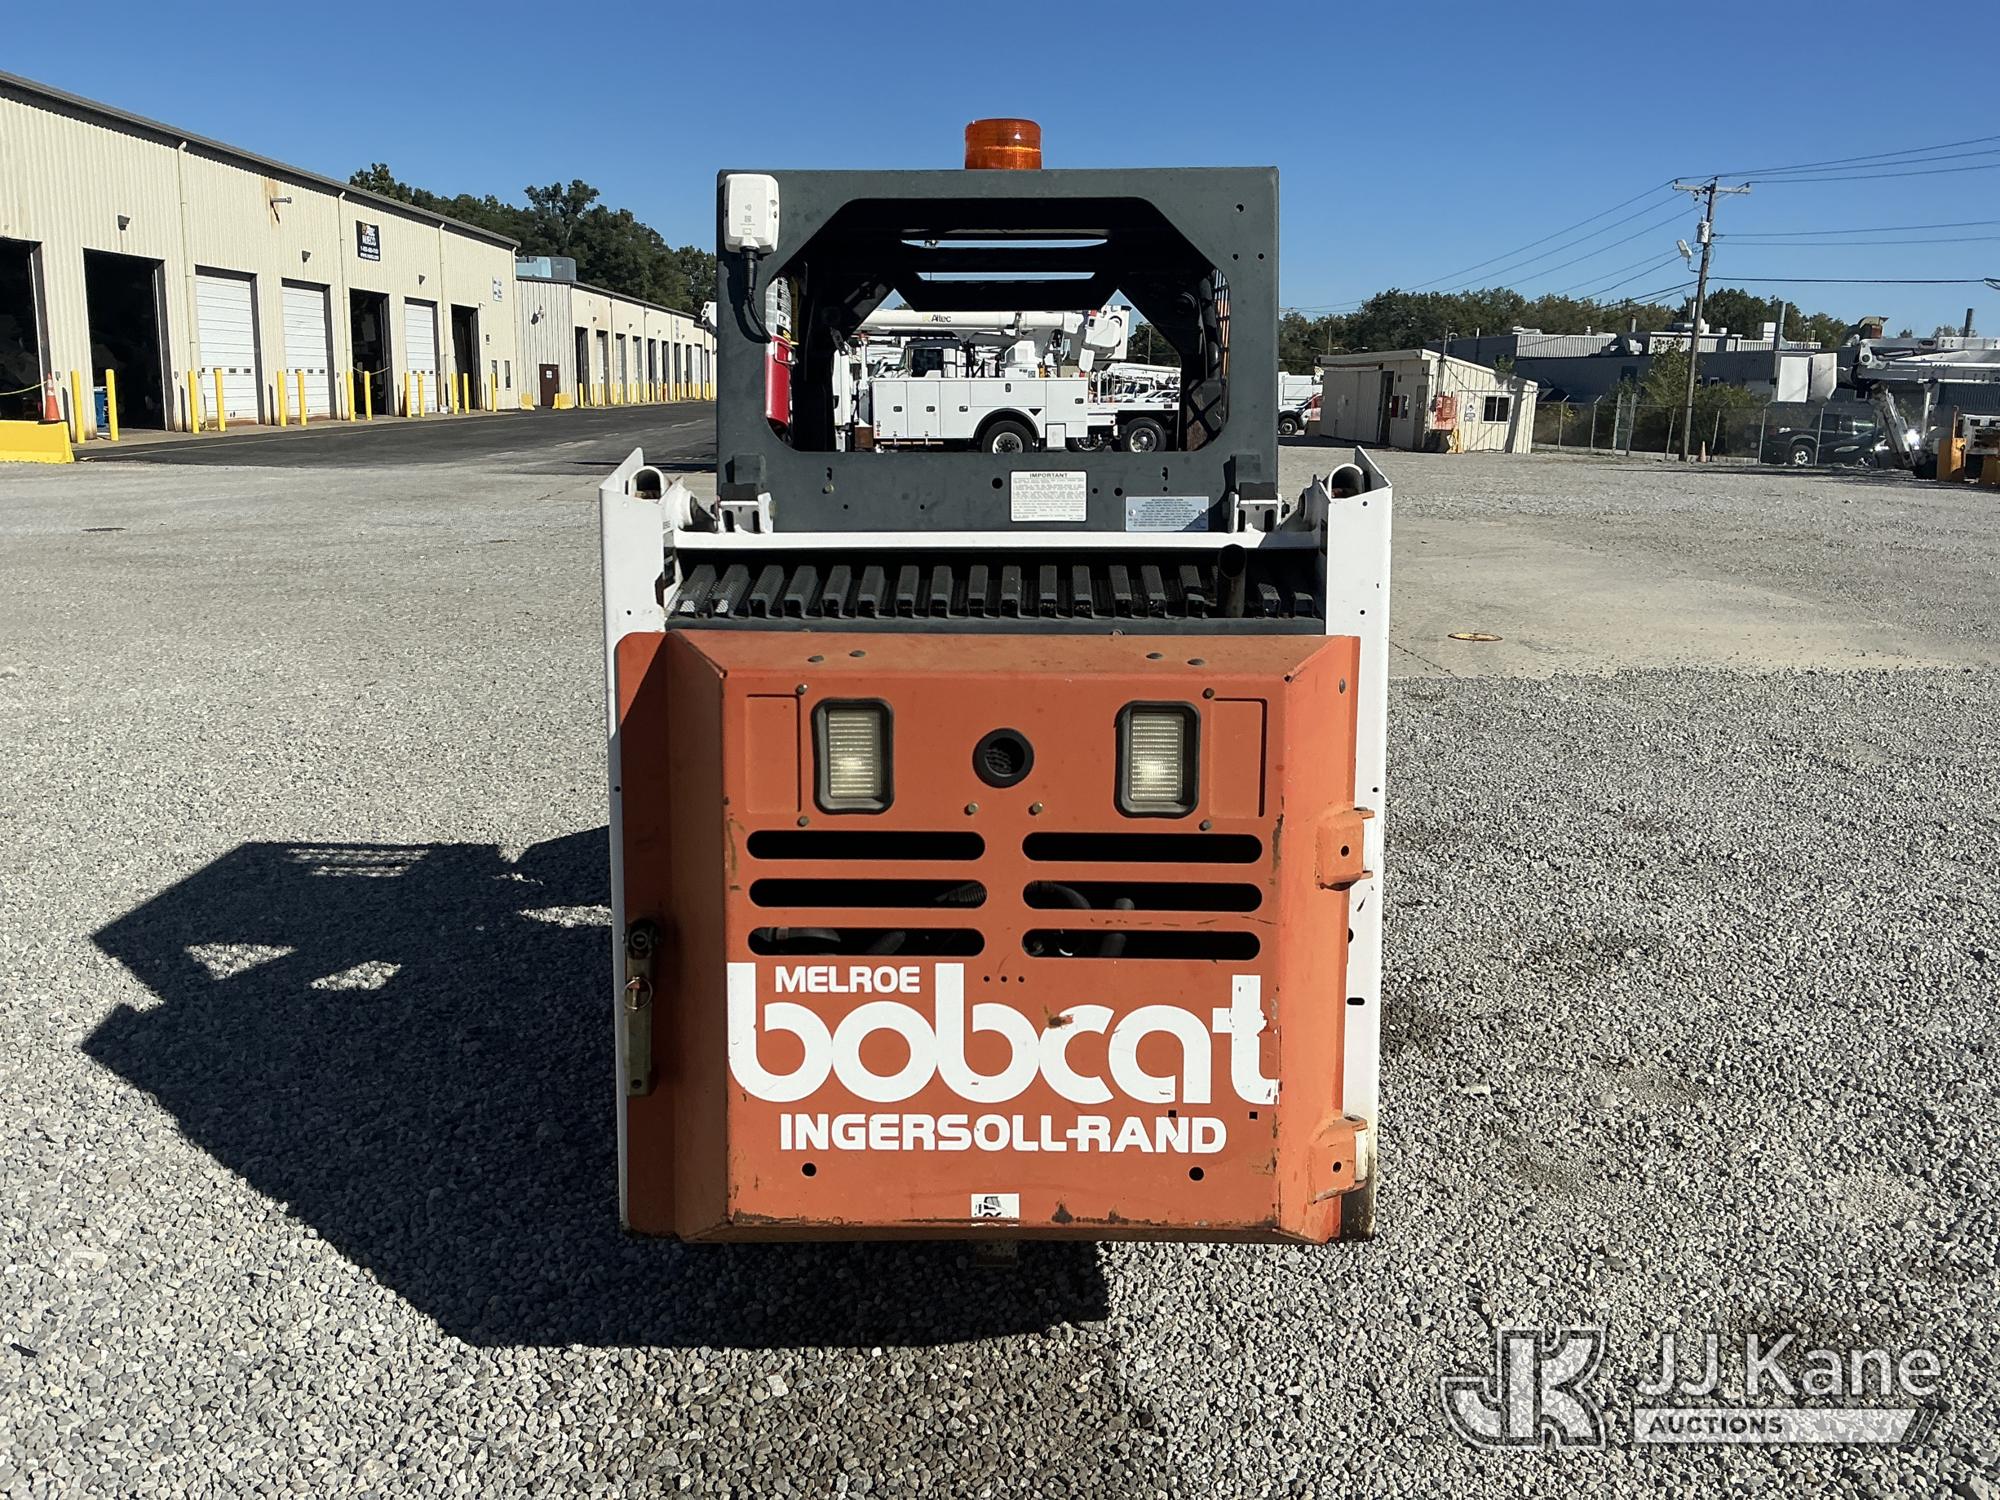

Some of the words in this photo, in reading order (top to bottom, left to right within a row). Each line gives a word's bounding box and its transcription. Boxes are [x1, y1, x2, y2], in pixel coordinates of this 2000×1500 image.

[931, 314, 952, 323] Altec
[775, 966, 920, 993] MELROE
[727, 962, 1280, 1105] bobcat
[780, 1113, 1227, 1154] INGERSOLL-RAND
